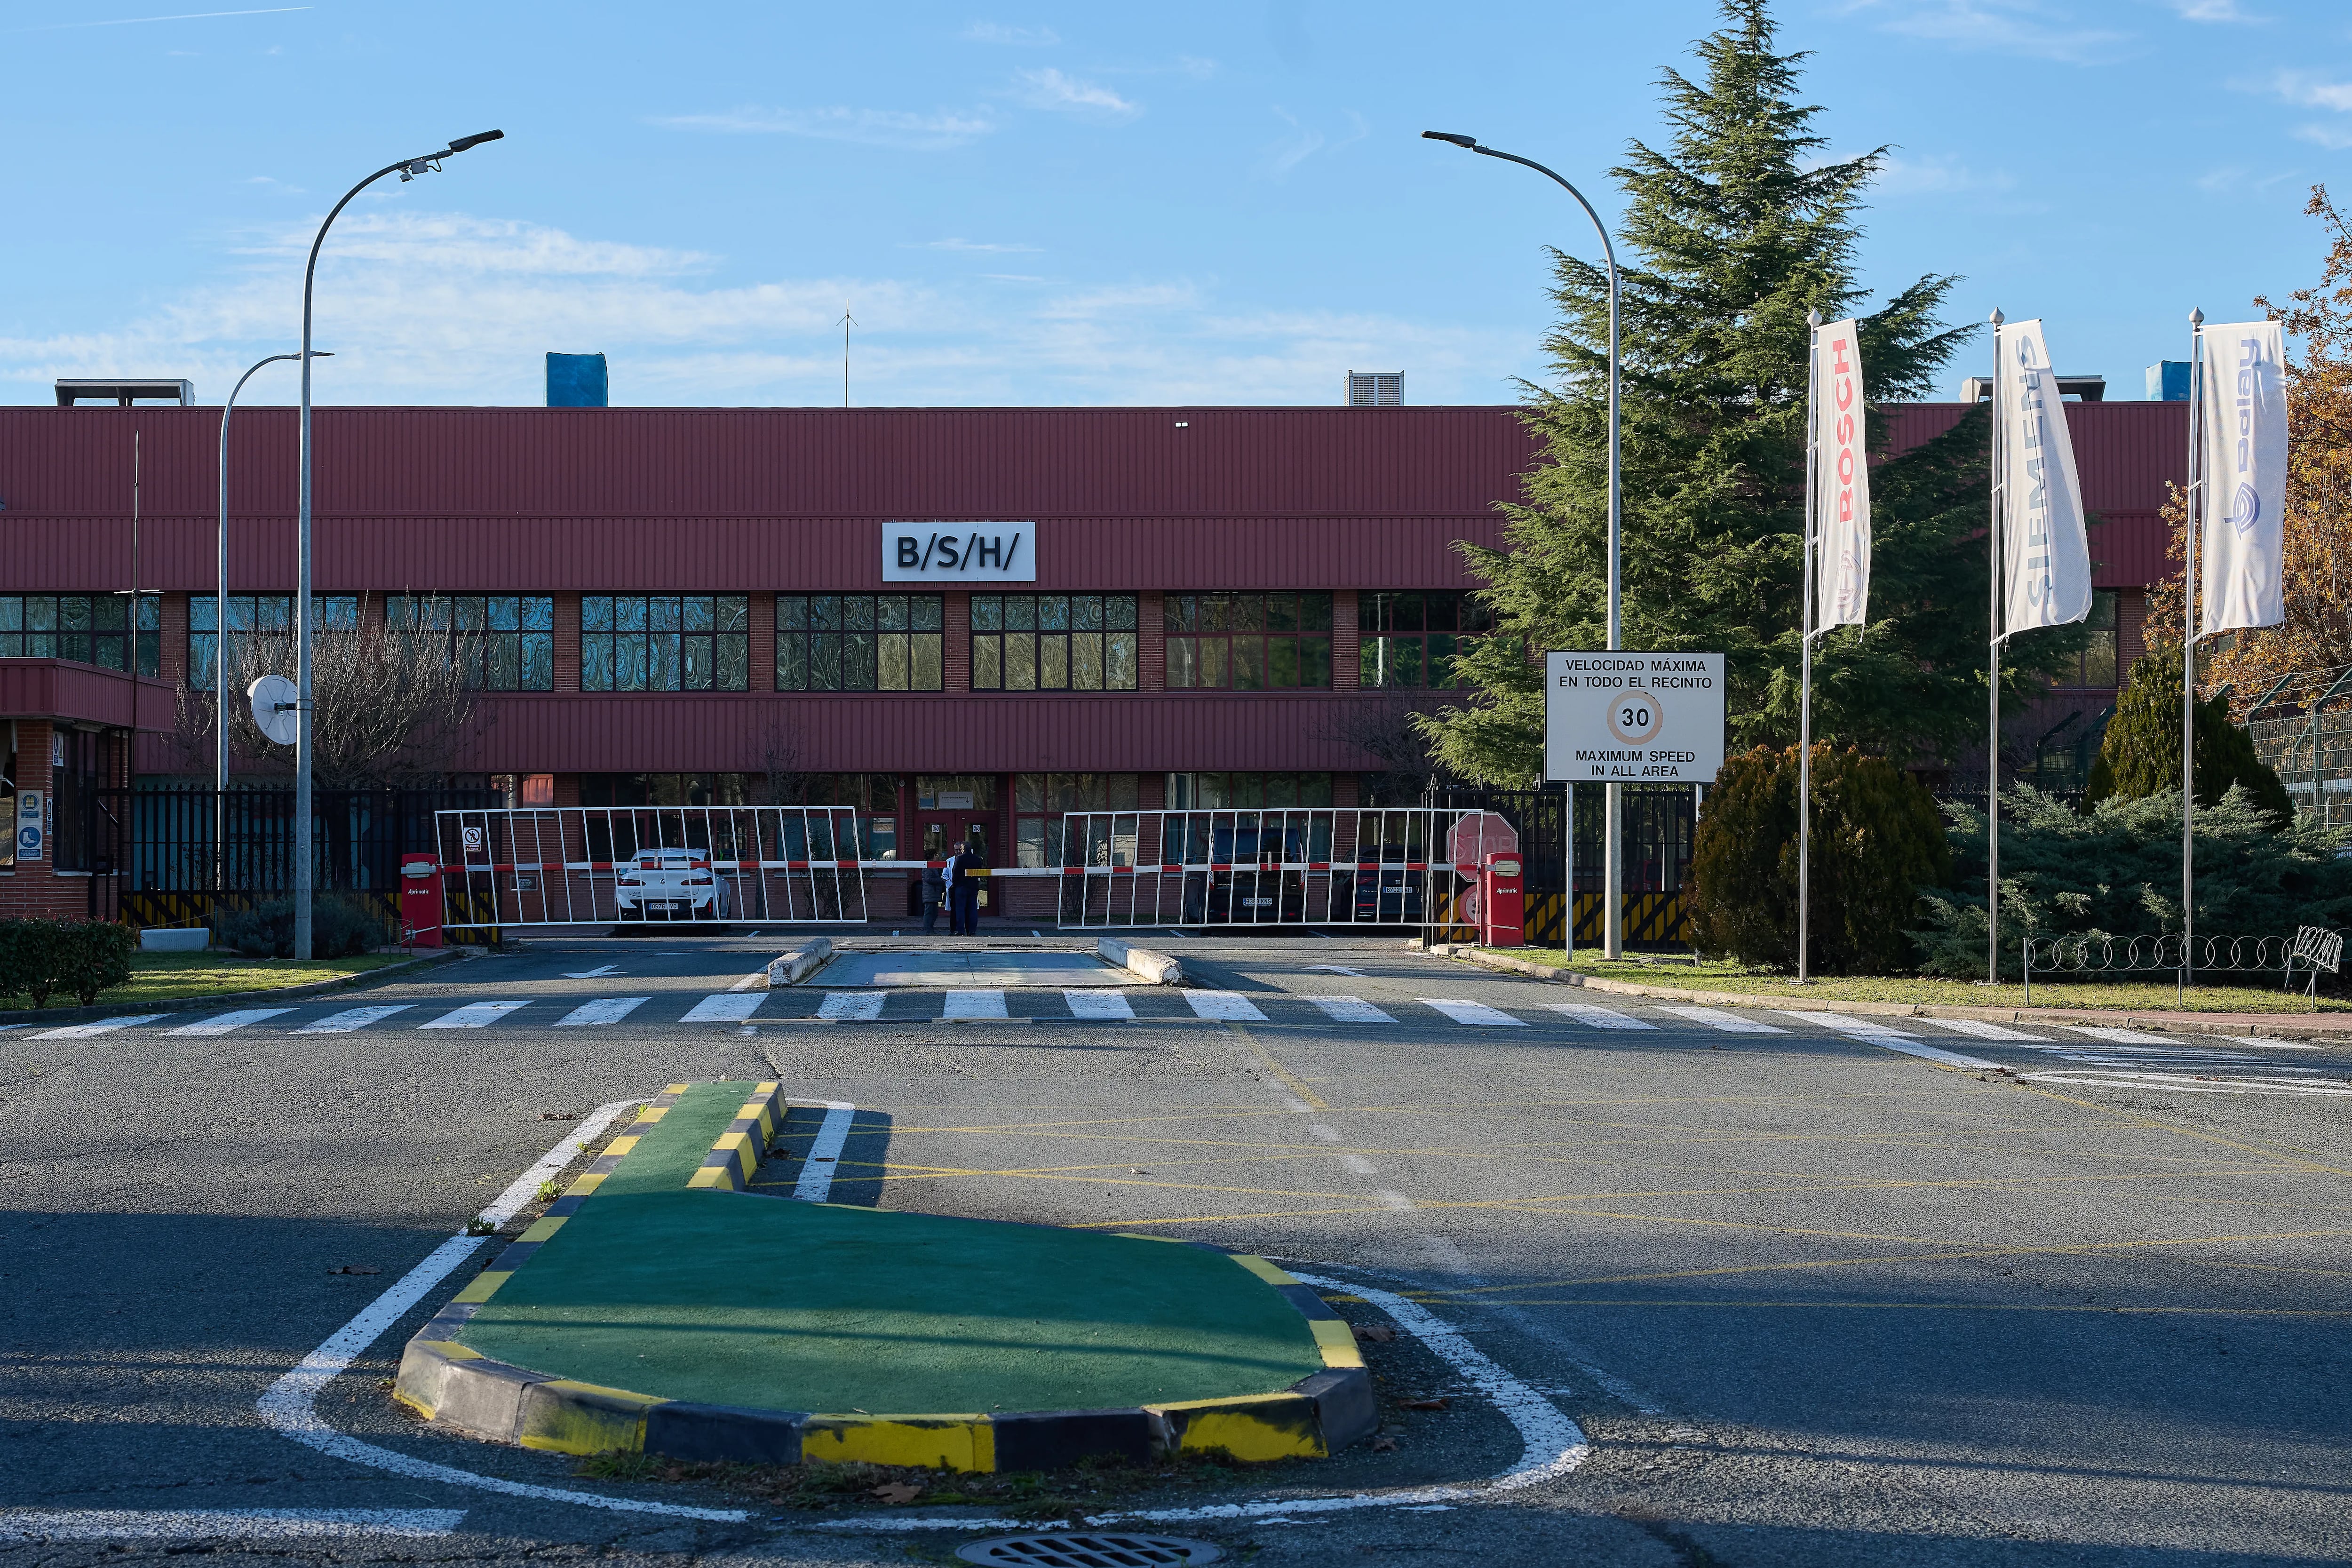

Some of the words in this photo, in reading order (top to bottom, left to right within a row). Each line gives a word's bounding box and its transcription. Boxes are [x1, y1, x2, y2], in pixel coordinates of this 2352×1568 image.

[2236, 339, 2262, 473] Balay
[1832, 338, 1854, 523] BOSCH
[2015, 335, 2053, 608] SIEMENS
[898, 532, 1020, 571] B/S/H/
[1565, 659, 1645, 671] VELOCIDAD
[1651, 658, 1706, 672] MÁXIMA
[1559, 676, 1578, 687] EN
[1583, 676, 1623, 688] TODO
[1629, 677, 1646, 688] EL
[1652, 677, 1712, 689] RECINTO
[1621, 708, 1649, 727] 30
[1576, 750, 1643, 762] MAXIMUM
[1649, 751, 1695, 763] SPEED
[1591, 765, 1605, 776] IN
[1611, 765, 1636, 776] ALL
[1641, 765, 1679, 777] AREA
[1452, 834, 1512, 860] STOP
